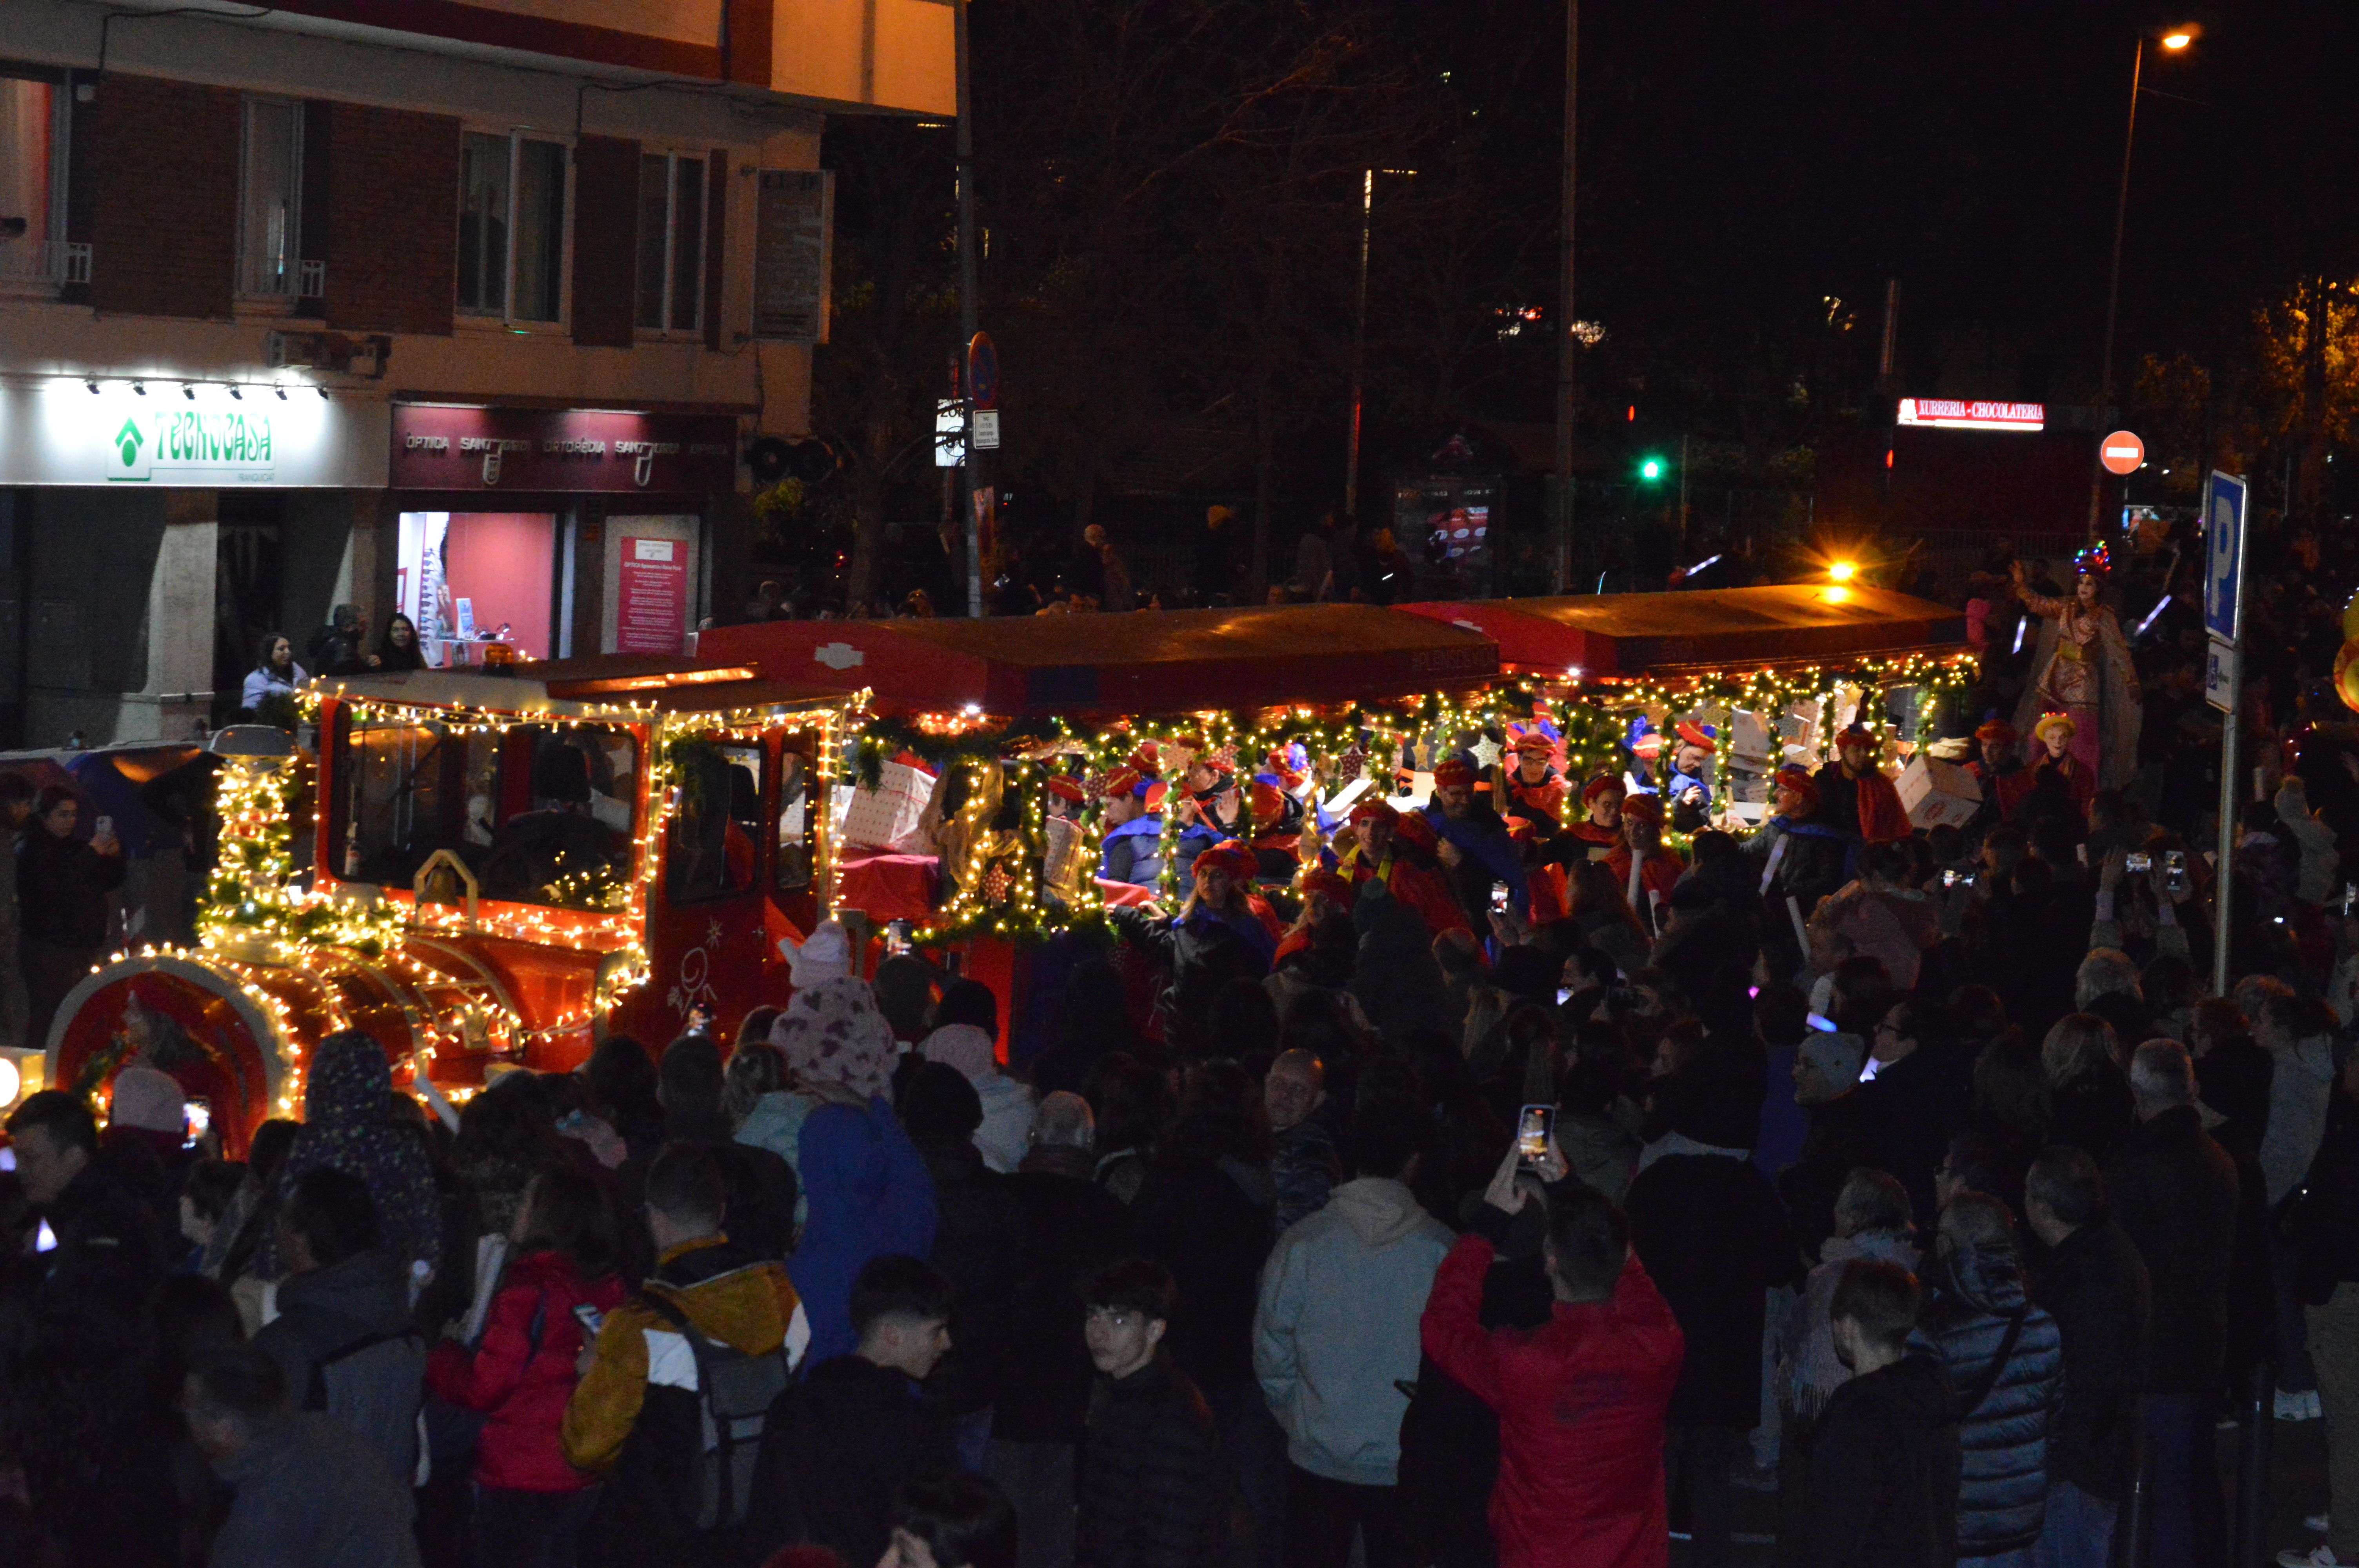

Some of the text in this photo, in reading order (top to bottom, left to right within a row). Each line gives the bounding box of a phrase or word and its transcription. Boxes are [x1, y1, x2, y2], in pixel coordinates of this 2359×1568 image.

[1918, 400, 1966, 416] XURRERIA
[1972, 402, 2044, 419] CHOCOLATERIA
[155, 411, 271, 461] TECNOCASA
[2210, 496, 2235, 617] P
